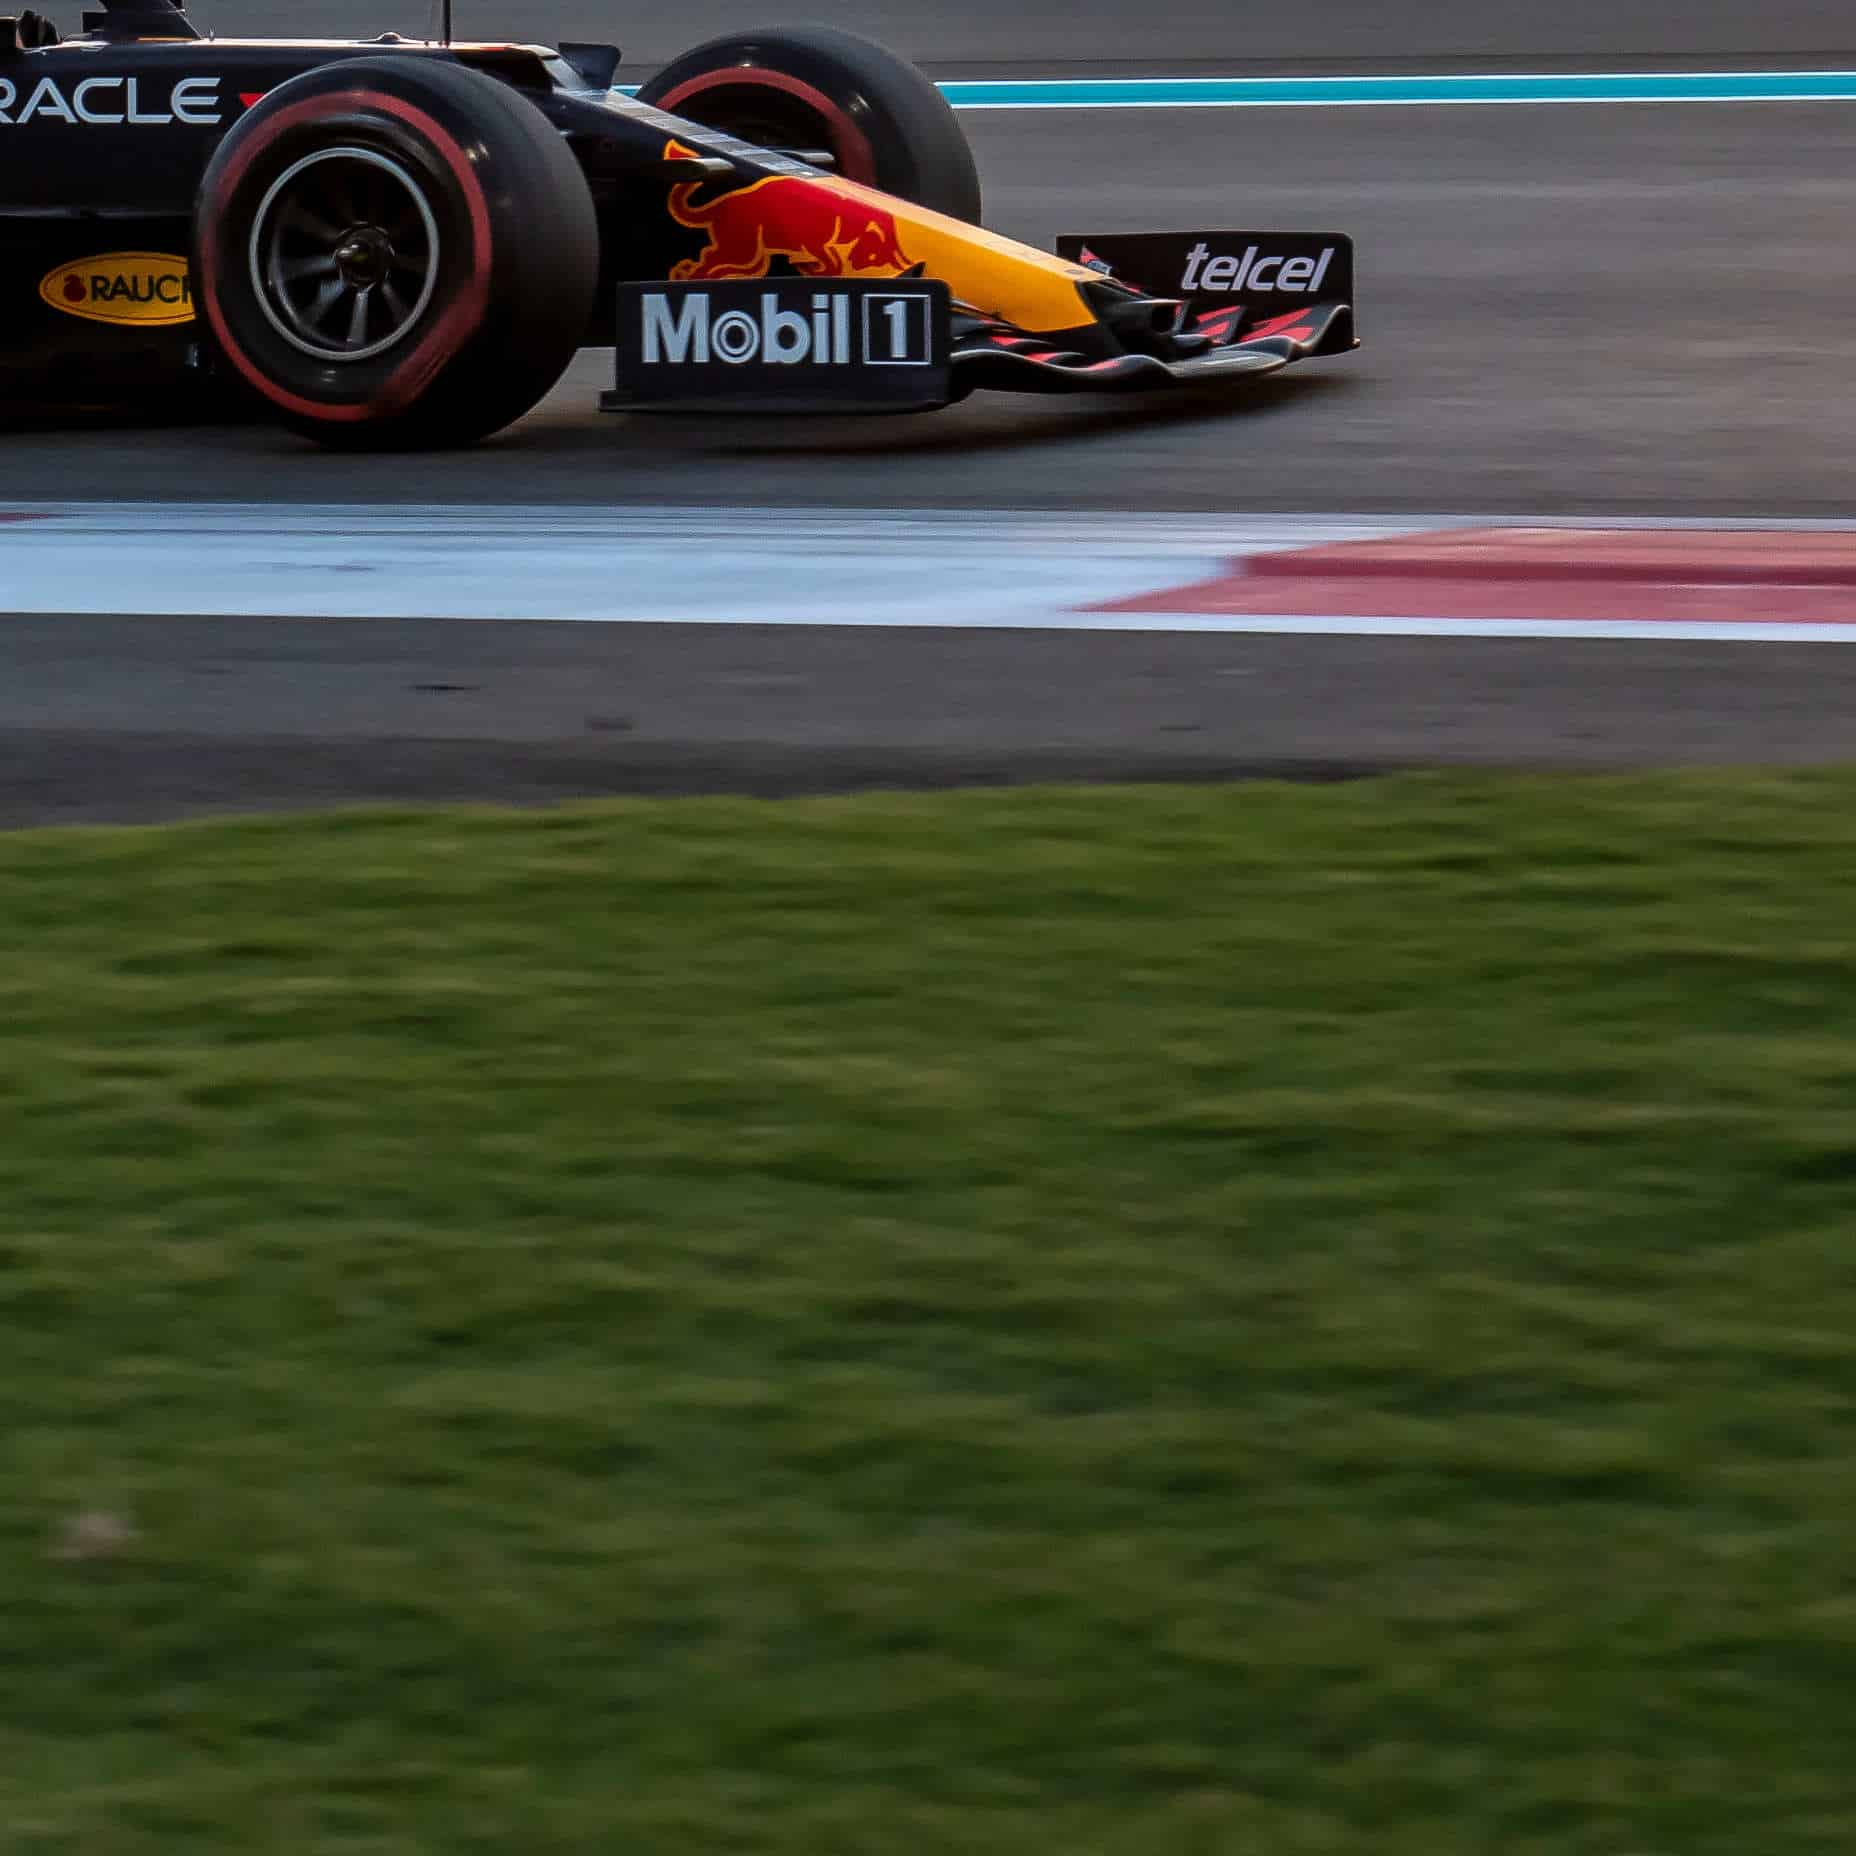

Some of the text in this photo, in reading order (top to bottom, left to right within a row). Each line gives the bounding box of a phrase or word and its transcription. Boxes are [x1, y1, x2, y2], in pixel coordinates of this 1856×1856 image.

[1180, 242, 1336, 293] telcel
[642, 293, 908, 365] Mobil 1
